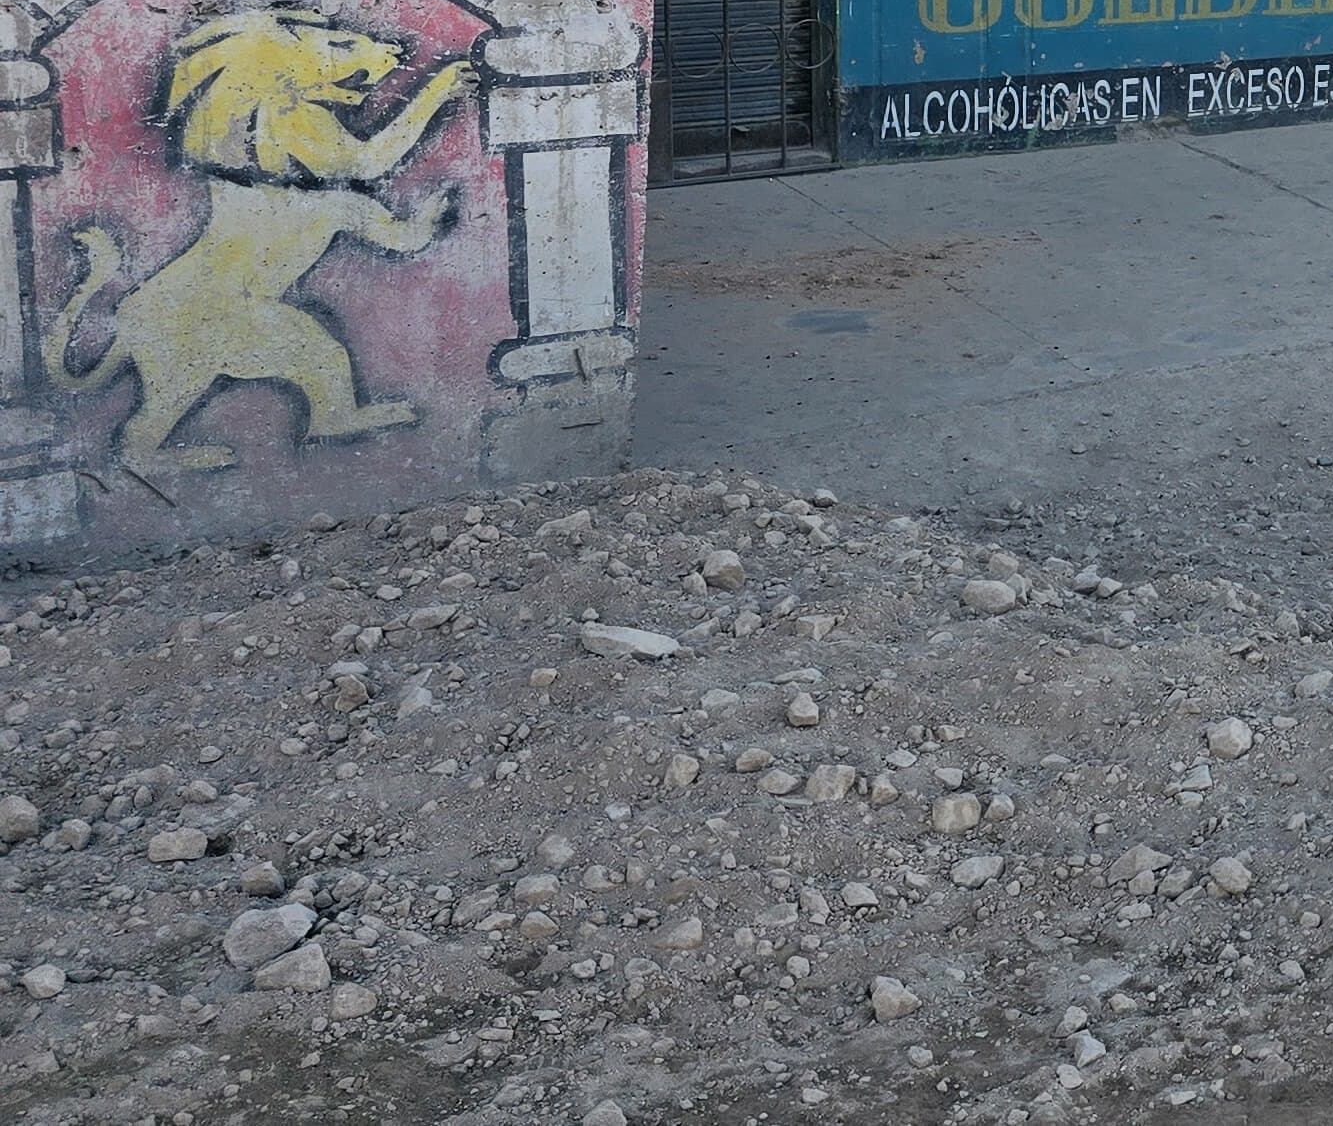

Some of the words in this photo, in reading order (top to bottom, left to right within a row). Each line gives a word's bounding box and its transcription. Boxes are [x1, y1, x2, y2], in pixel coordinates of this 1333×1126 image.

[880, 73, 1111, 140] ALCOHÓLICAS
[1122, 75, 1161, 123] EN
[1187, 65, 1304, 118] EXCESO
